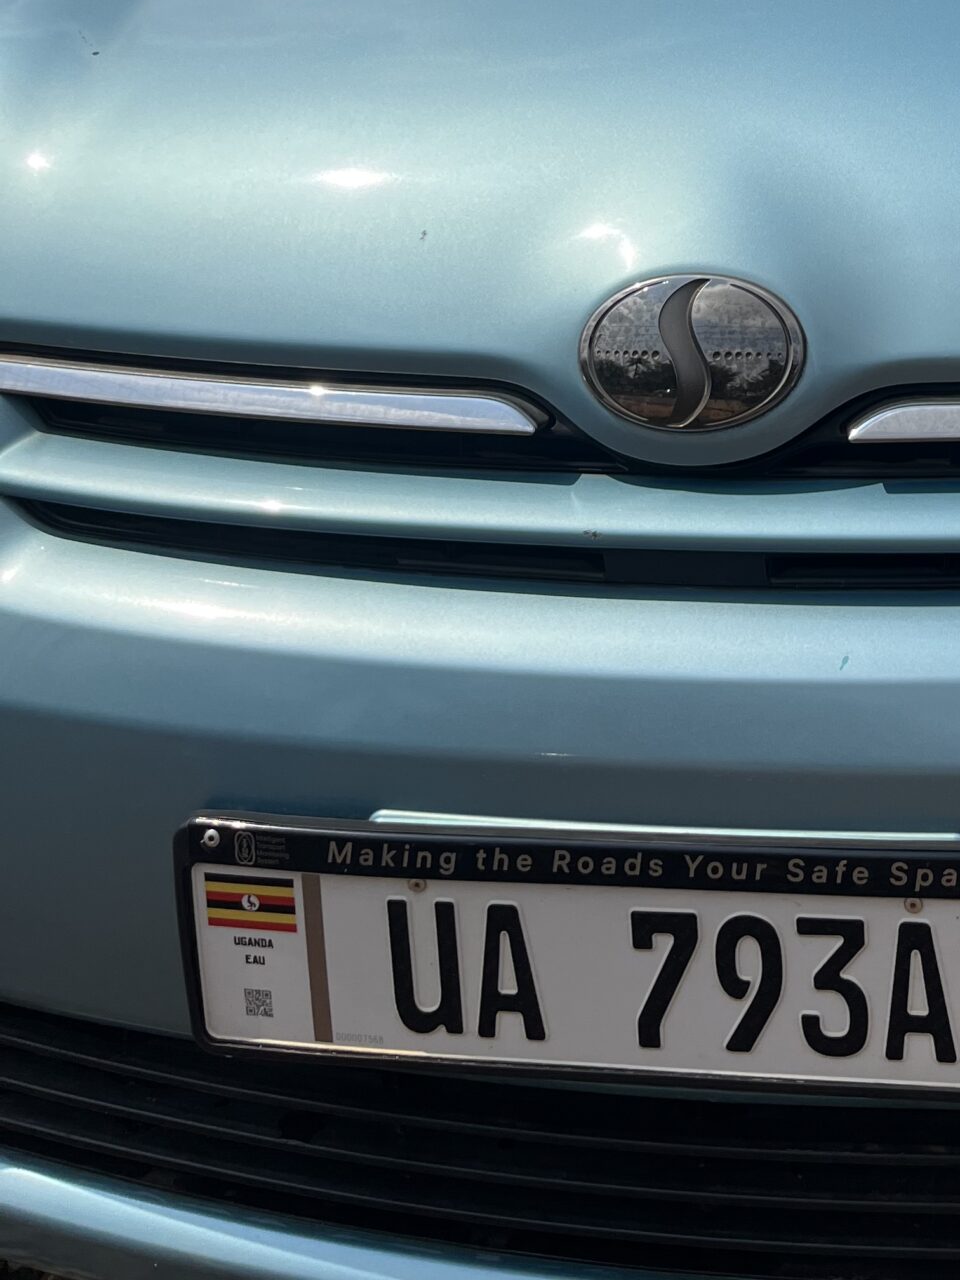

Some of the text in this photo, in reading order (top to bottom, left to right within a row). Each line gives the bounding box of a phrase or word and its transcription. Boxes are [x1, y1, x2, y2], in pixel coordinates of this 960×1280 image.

[327, 841, 457, 875] Making
[476, 847, 533, 871] the
[552, 850, 663, 877] Roads
[684, 854, 767, 880] Your
[786, 858, 869, 884] Safe
[233, 935, 274, 949] UGANDA
[245, 954, 266, 966] EAU
[387, 899, 546, 1041] UA
